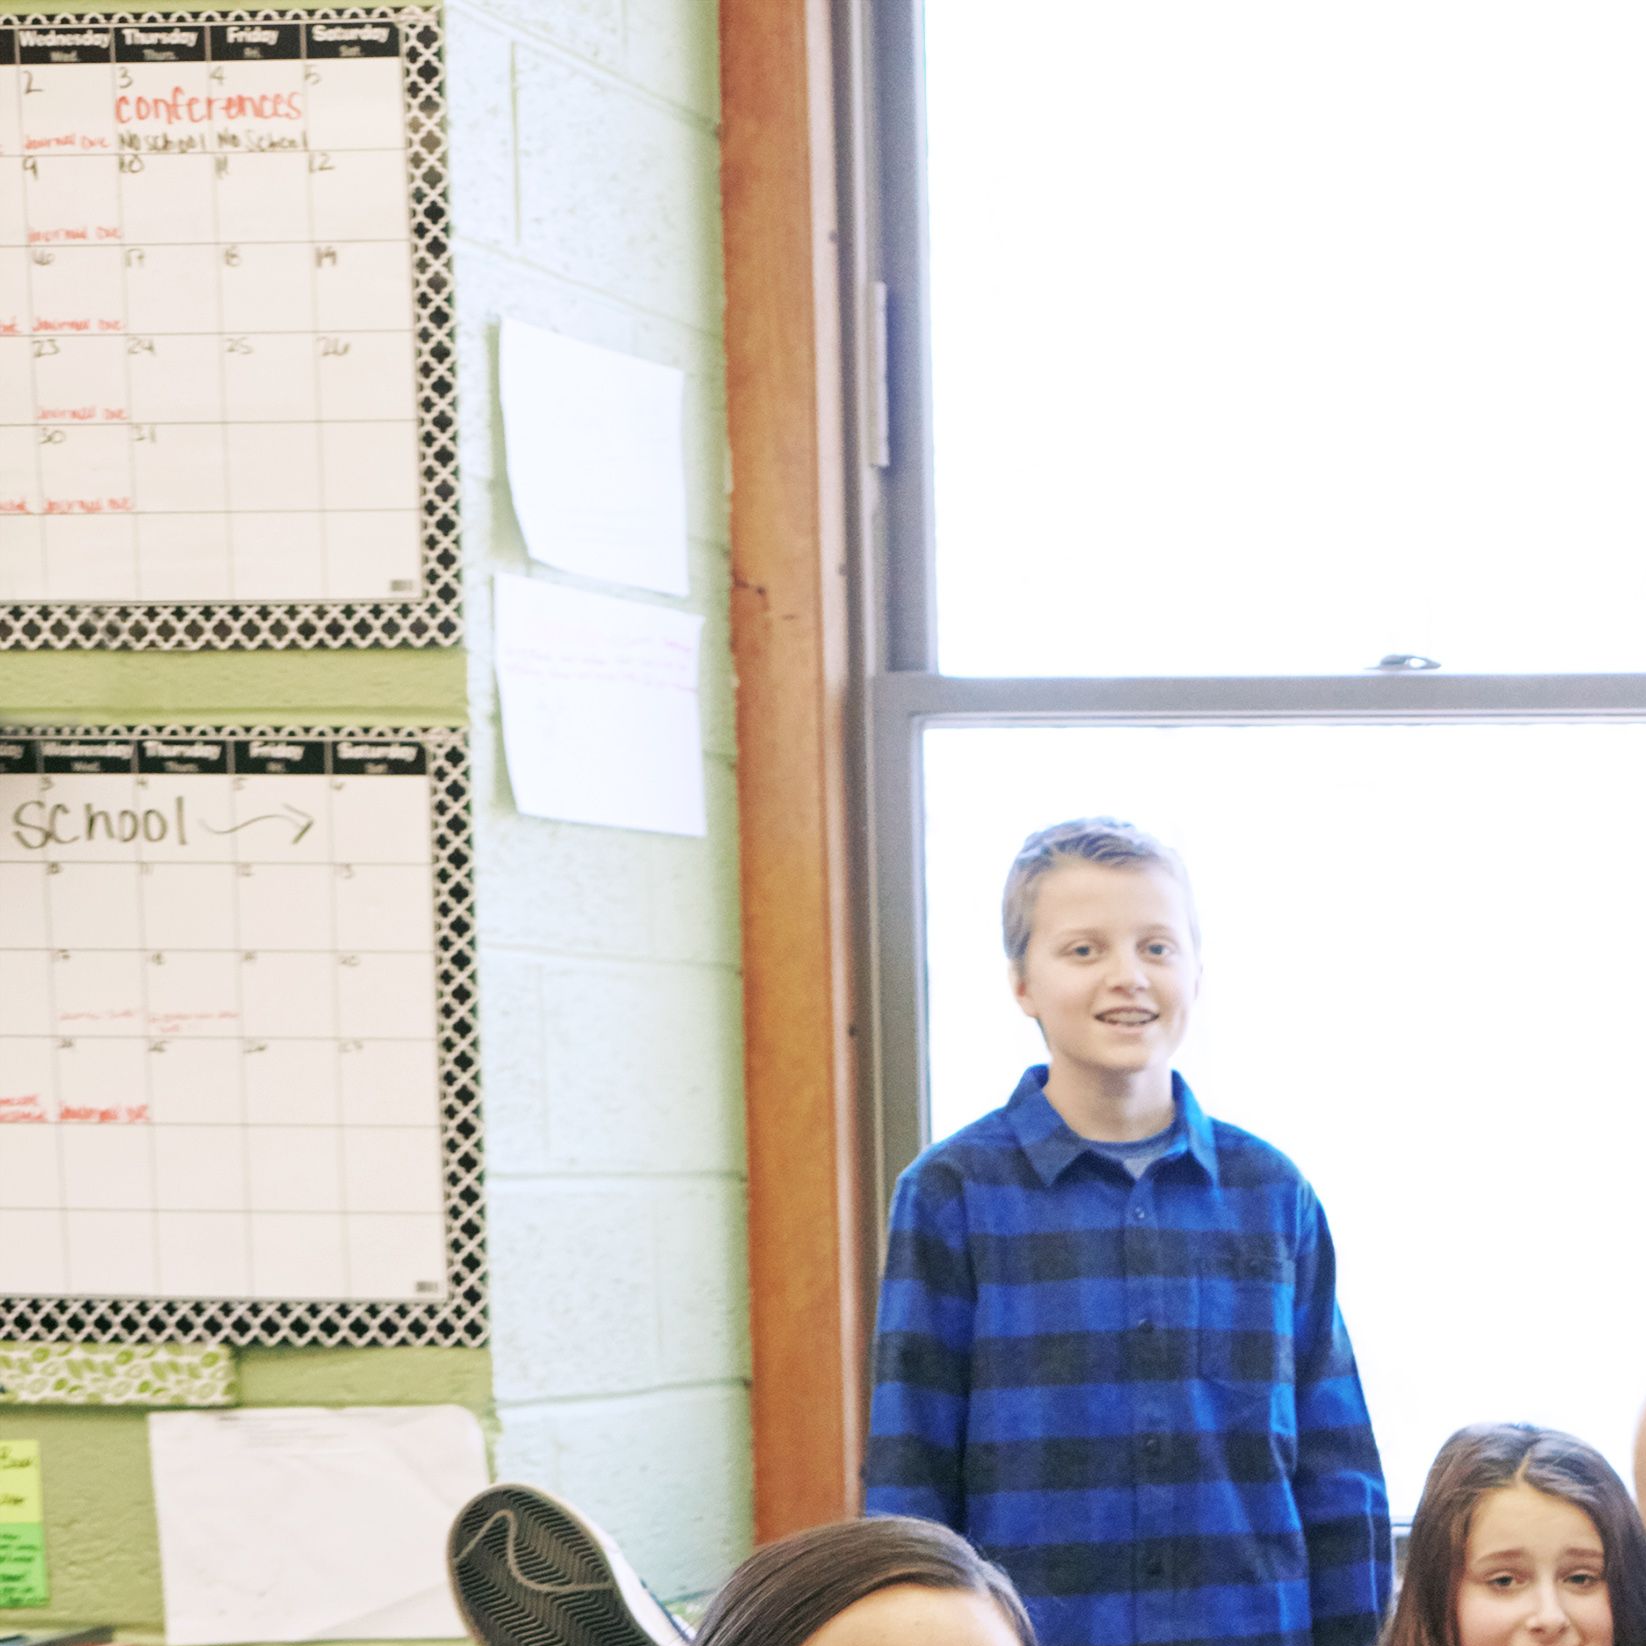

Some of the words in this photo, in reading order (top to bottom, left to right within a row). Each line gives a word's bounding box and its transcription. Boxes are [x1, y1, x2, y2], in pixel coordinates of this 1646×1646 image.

[19, 28, 111, 48] Wednesday
[122, 27, 199, 47] Thursday
[227, 25, 280, 46] Friday
[312, 23, 390, 44] Saturday
[23, 69, 44, 94] 2
[118, 66, 134, 89] 3
[208, 65, 225, 86] 4
[303, 64, 322, 86] 5
[118, 130, 142, 151] No
[217, 127, 241, 148] No
[22, 154, 39, 182] 9
[118, 153, 146, 174] 10
[308, 153, 336, 175] 12
[12, 795, 188, 850] School
